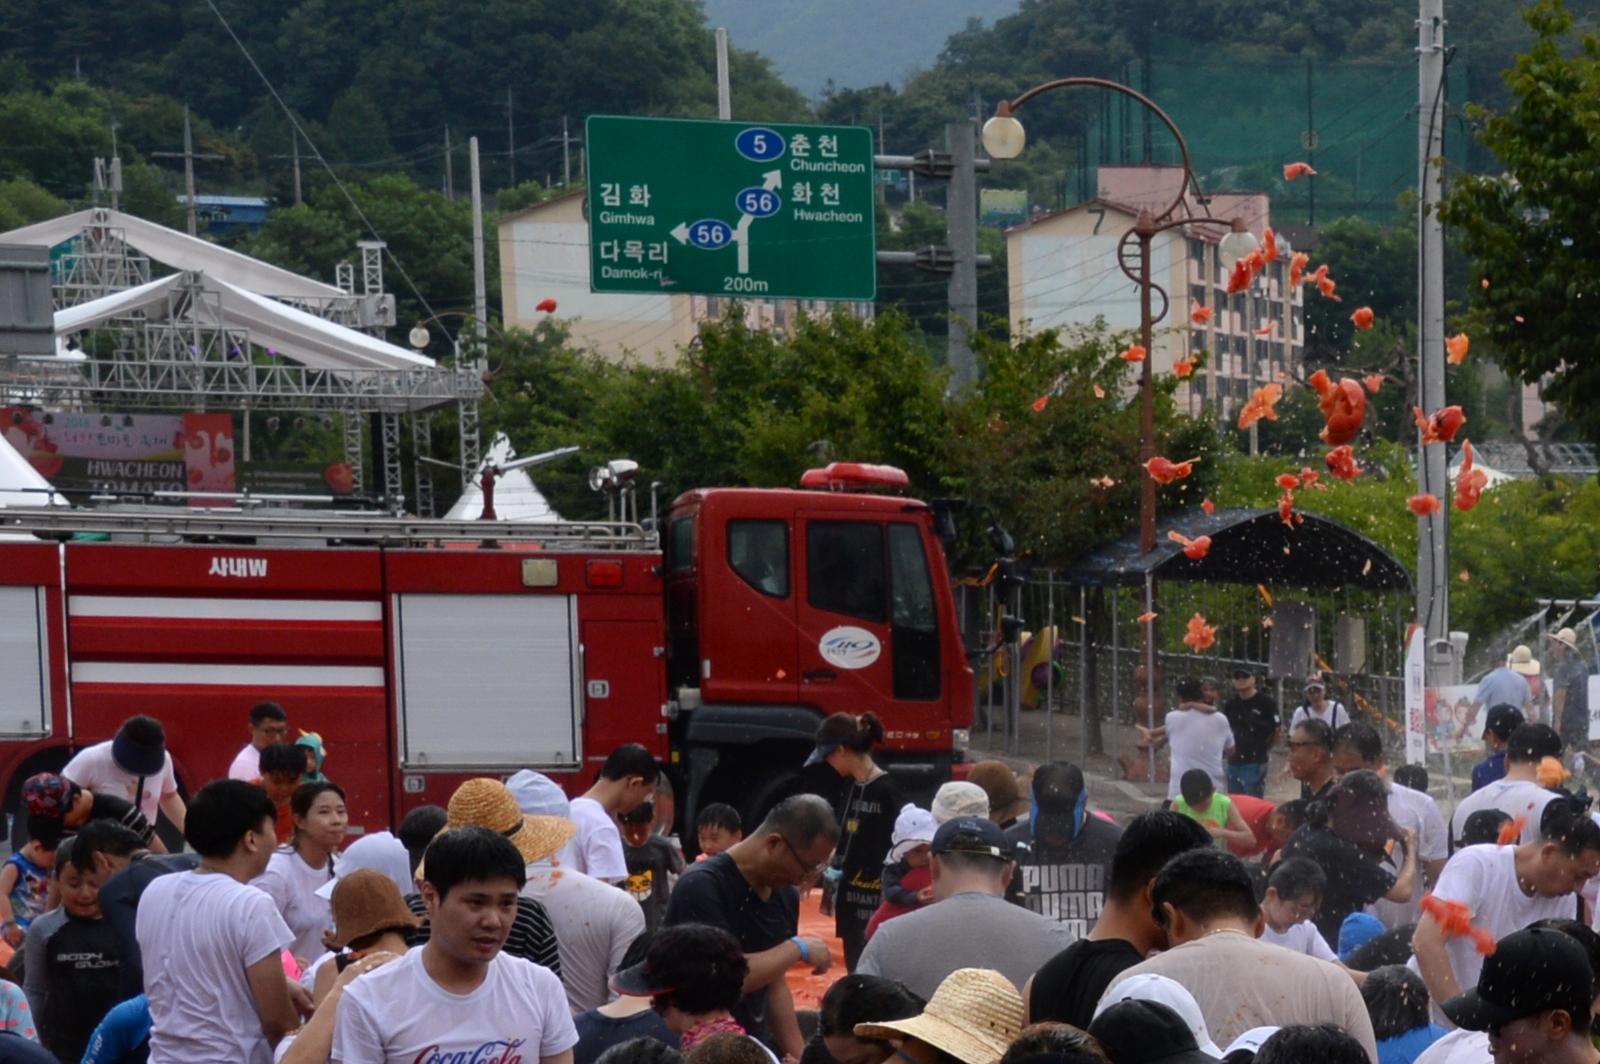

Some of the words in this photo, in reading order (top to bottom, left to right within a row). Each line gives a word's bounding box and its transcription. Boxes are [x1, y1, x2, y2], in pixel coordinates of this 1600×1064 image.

[754, 134, 766, 154] 5
[790, 133, 838, 157] 춘천
[790, 159, 865, 173] Chuncheon
[600, 183, 651, 207] 김화
[745, 193, 772, 212] 56
[792, 181, 840, 206] 화천
[599, 211, 655, 226] Gimhwa
[793, 208, 863, 223] Hwacheon
[697, 225, 723, 245] 56
[600, 239, 668, 264] 다목리
[601, 265, 663, 280] Damok-ri
[723, 276, 768, 292] 200m
[87, 460, 184, 478] HWACHEON
[208, 556, 268, 578] 사내W
[1021, 863, 1104, 893] PUMA
